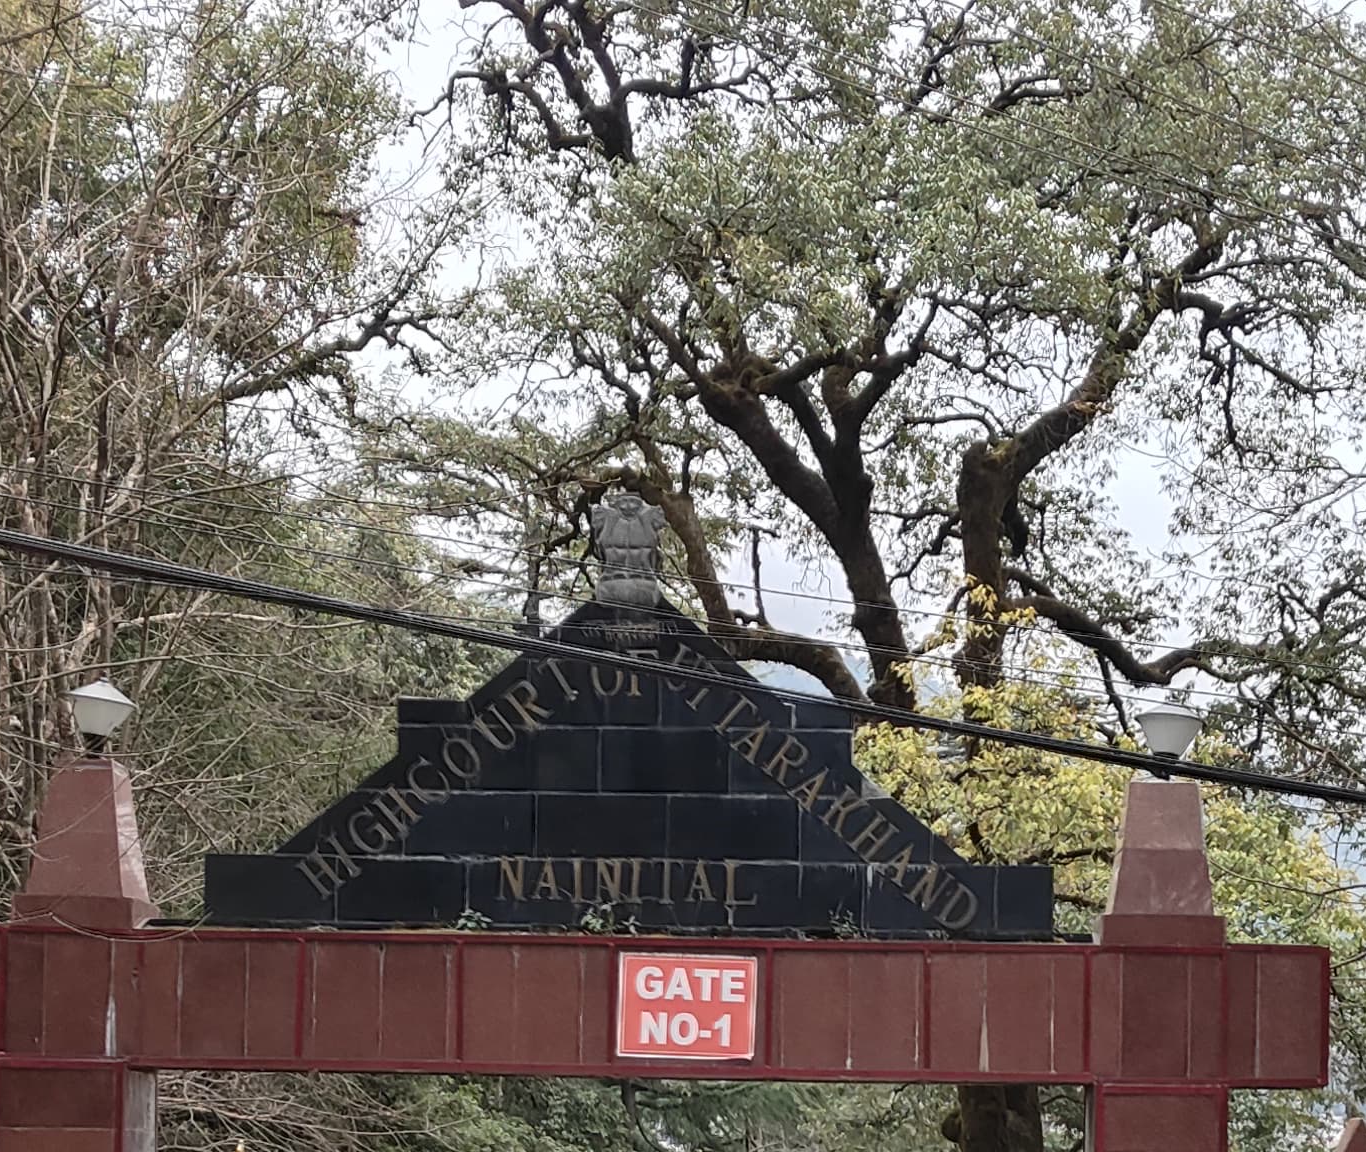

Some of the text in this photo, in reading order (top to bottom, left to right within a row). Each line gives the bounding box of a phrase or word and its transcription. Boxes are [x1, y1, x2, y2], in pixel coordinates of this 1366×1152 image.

[498, 855, 758, 906] NAINITAL
[636, 965, 747, 1003] GATE
[639, 1011, 732, 1048] NO-1
